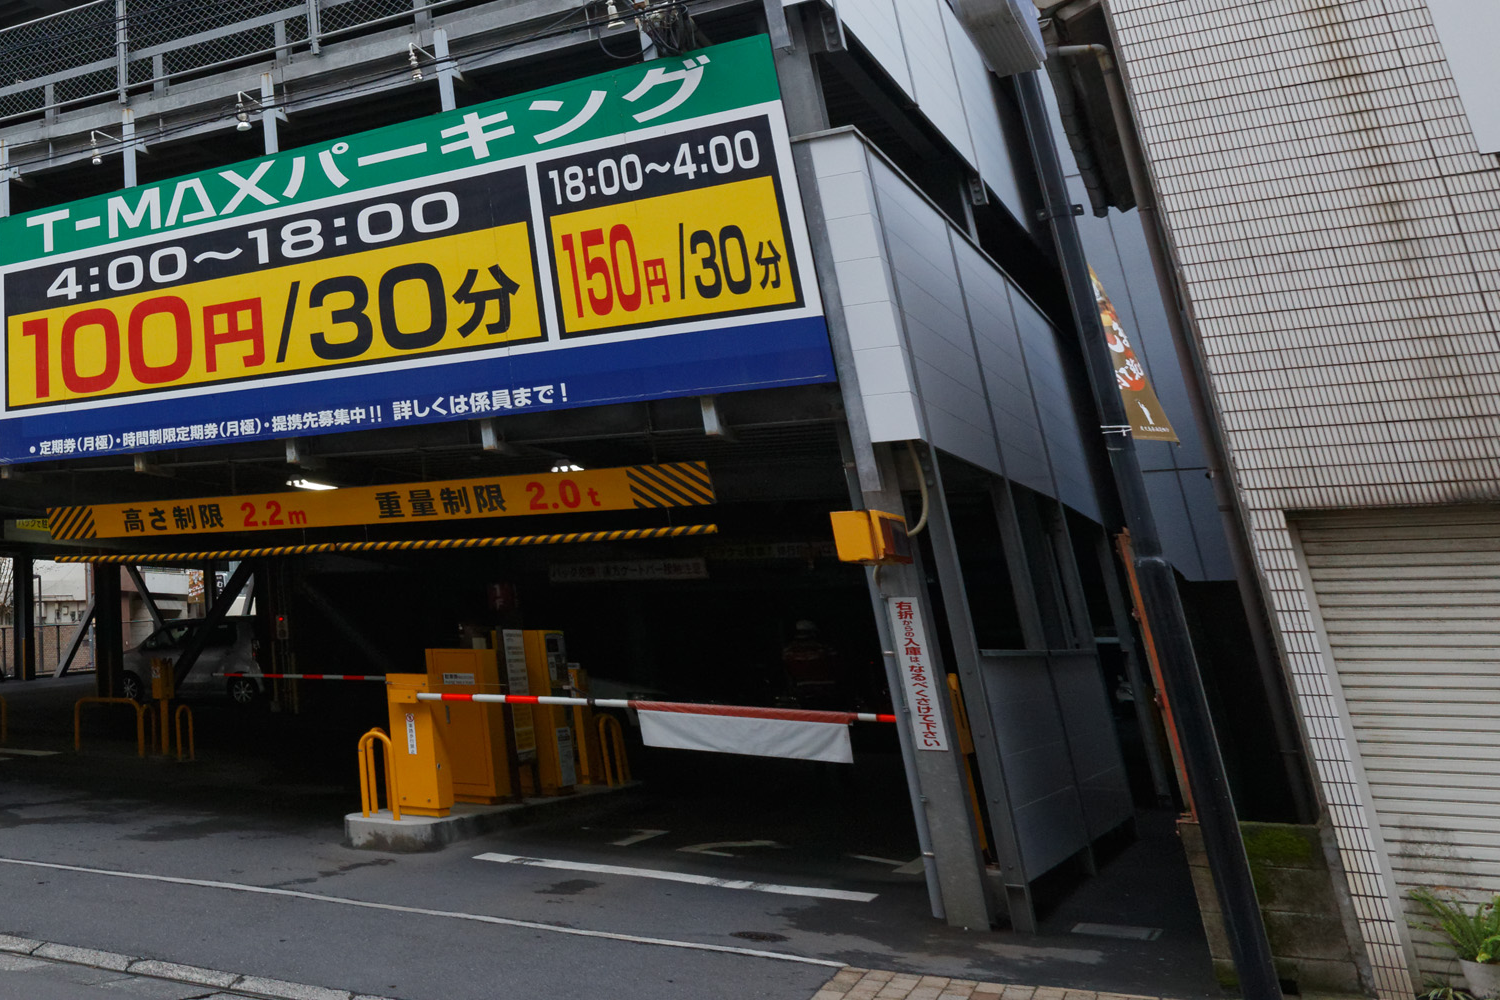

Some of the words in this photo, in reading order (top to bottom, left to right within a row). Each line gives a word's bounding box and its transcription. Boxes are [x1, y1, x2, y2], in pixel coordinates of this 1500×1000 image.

[26, 54, 712, 253] T-MAXパーキング
[561, 222, 782, 319] 150円/30分
[21, 263, 520, 399] 100円/30分
[121, 503, 224, 533] 高さ制限
[240, 500, 307, 527] 2.2m
[375, 484, 507, 519] 重量制限
